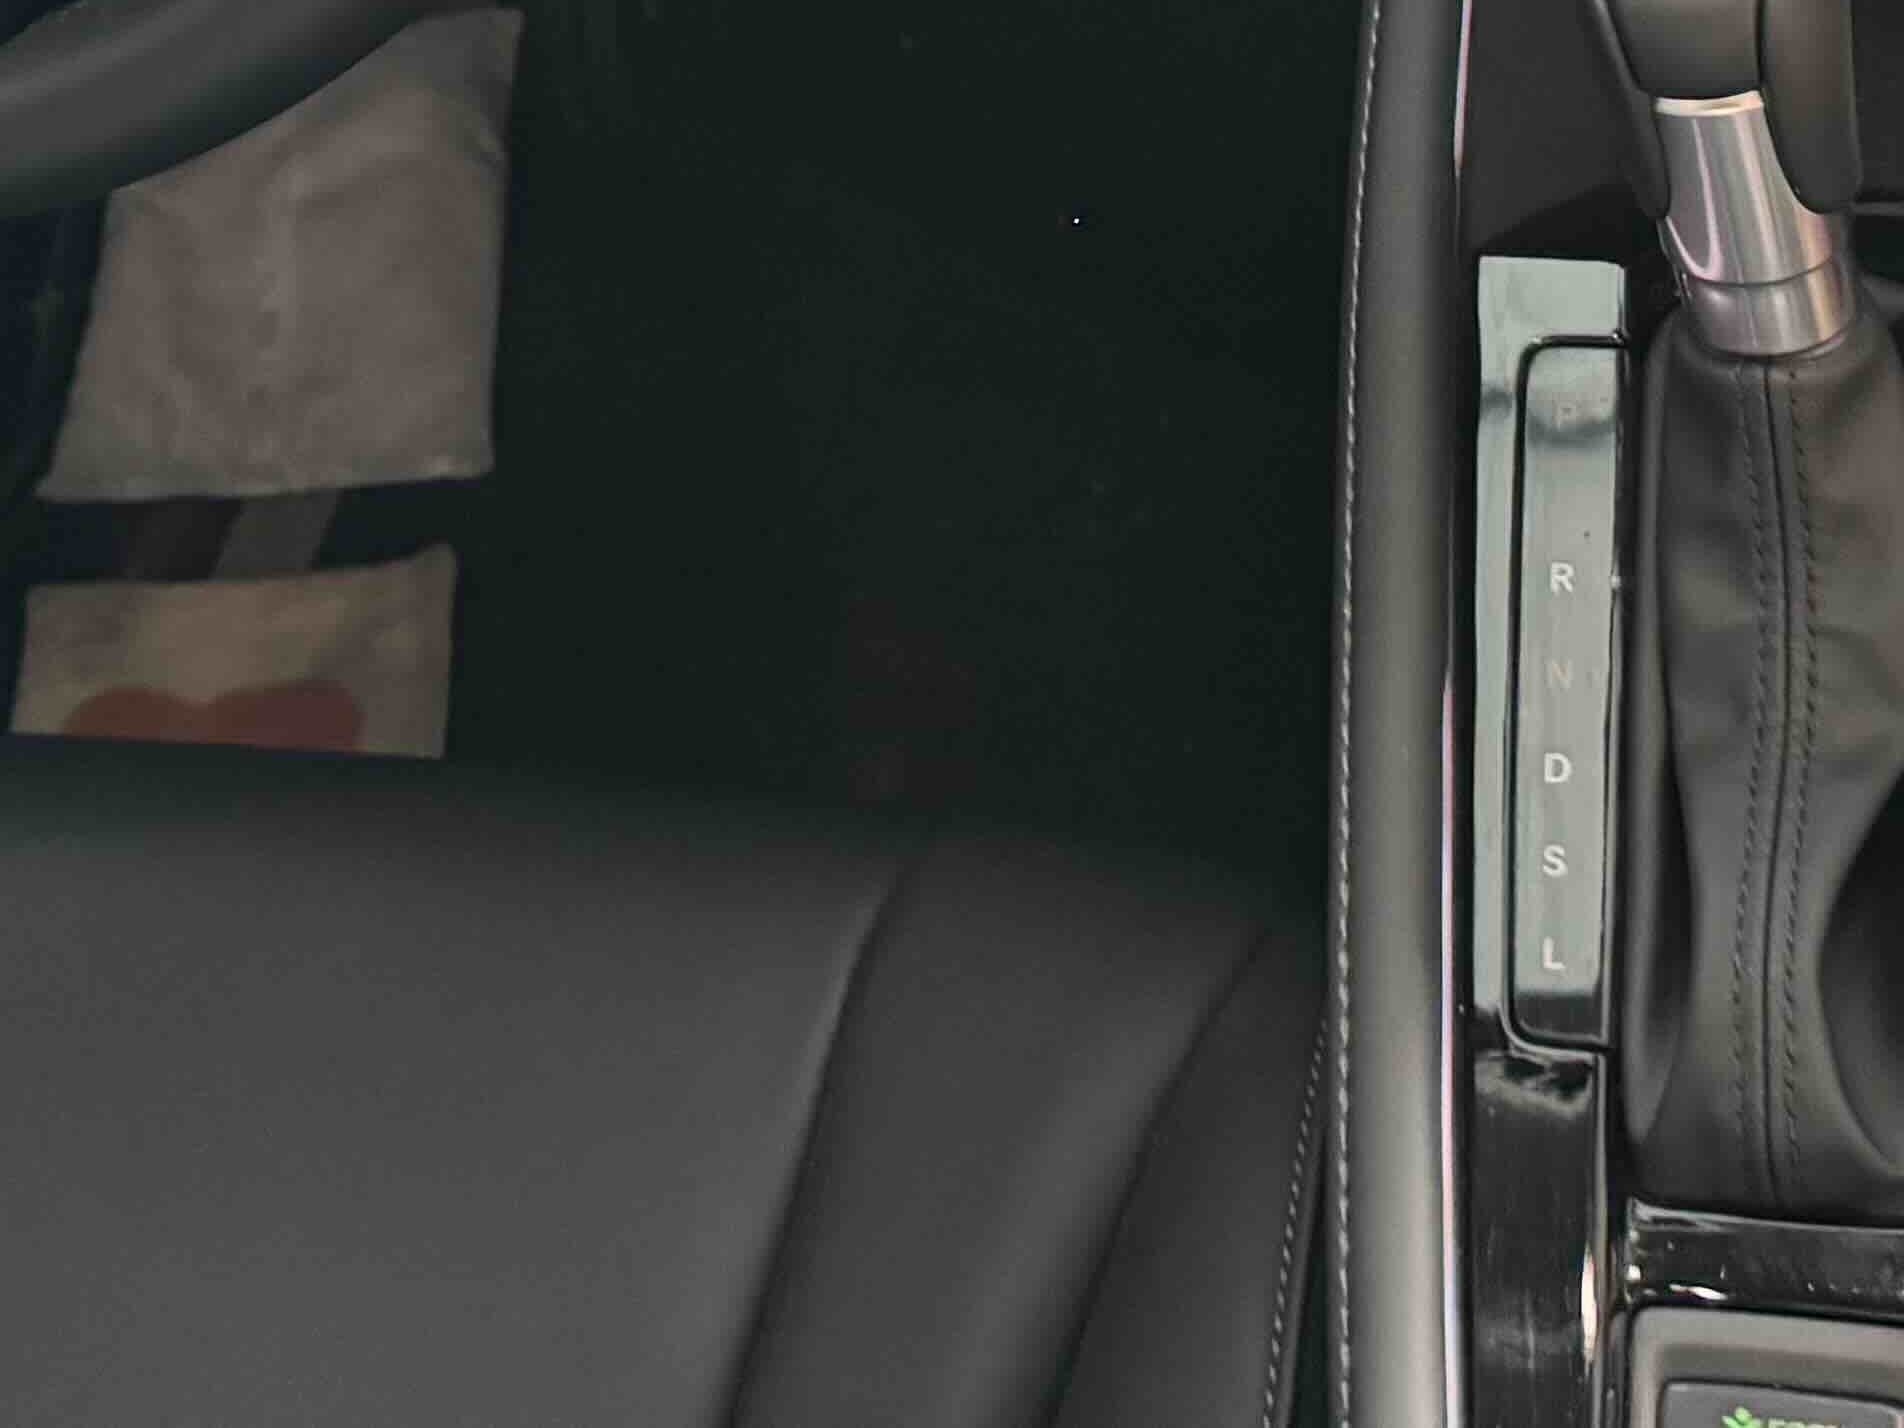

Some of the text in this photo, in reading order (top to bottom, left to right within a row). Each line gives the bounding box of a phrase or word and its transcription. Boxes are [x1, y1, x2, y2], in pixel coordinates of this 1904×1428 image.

[1549, 560, 1576, 594] R
[1542, 751, 1574, 785] D
[1542, 844, 1568, 878] S
[1542, 935, 1567, 971] L
